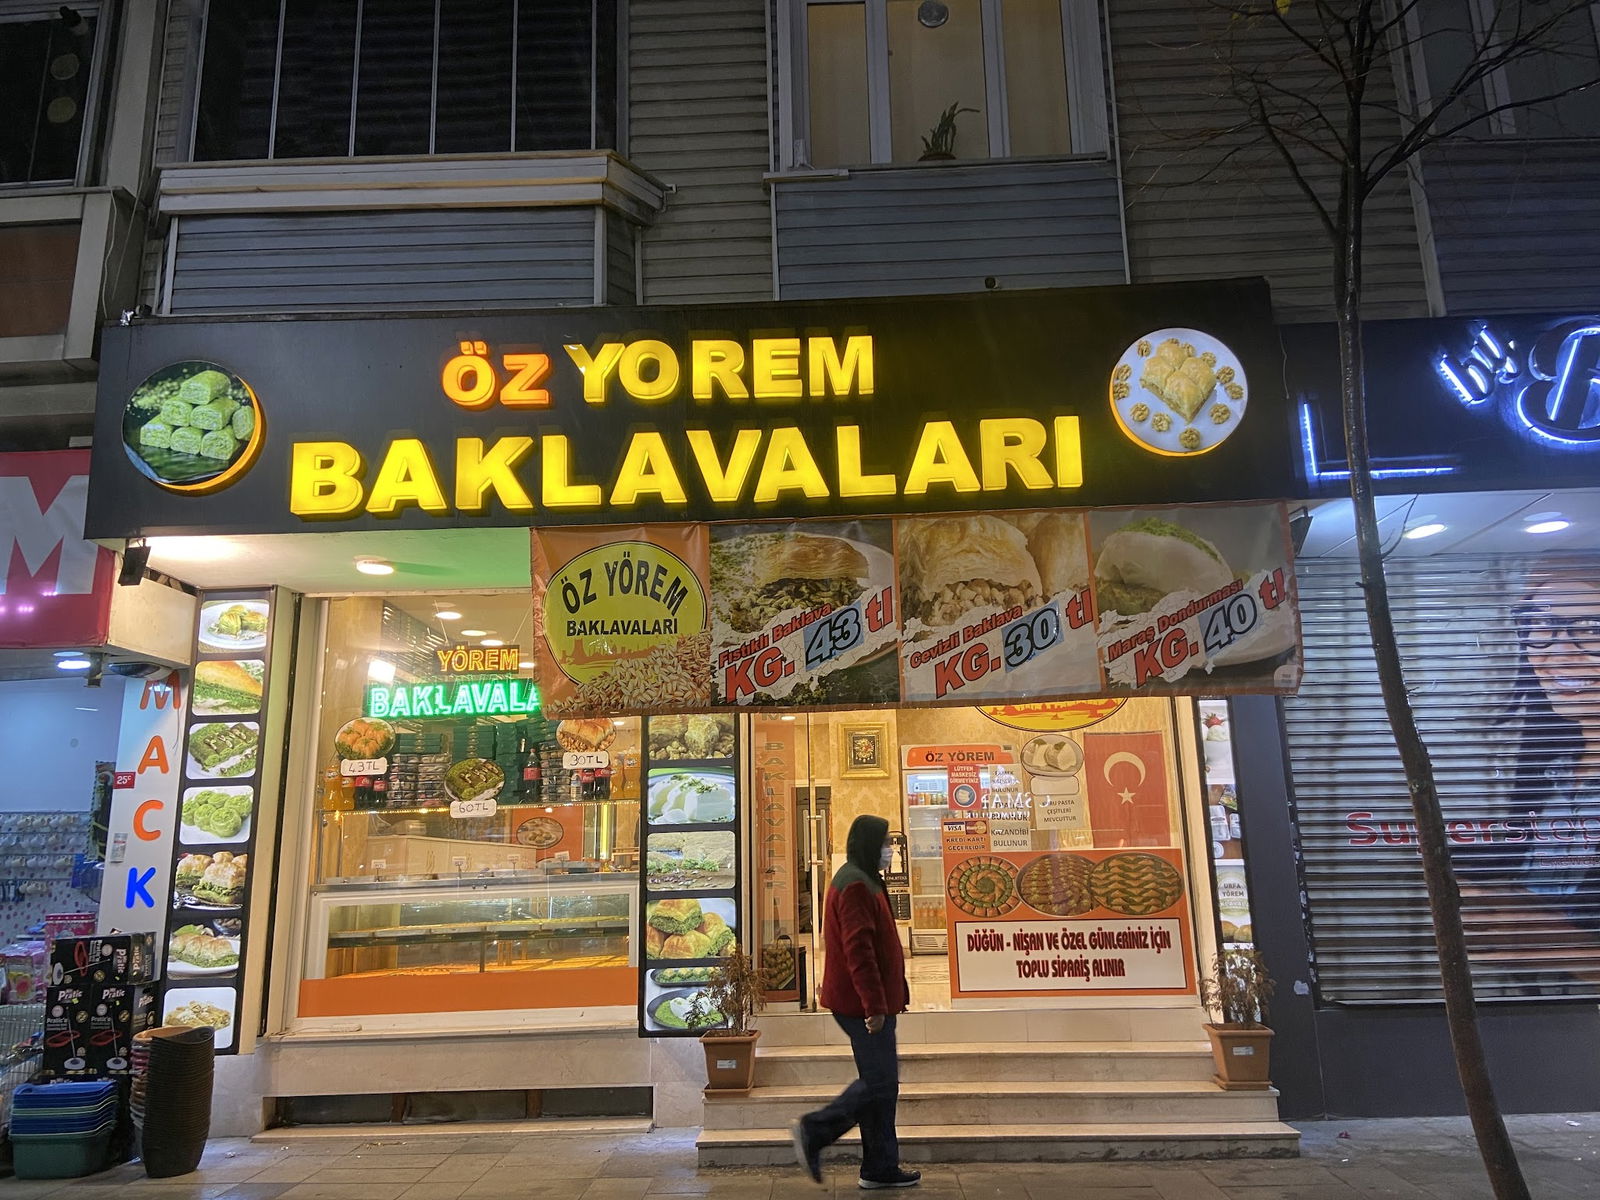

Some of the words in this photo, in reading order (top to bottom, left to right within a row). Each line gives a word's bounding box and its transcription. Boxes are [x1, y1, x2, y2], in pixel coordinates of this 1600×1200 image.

[442, 341, 551, 406] ÖZ
[563, 335, 875, 403] YOREM
[290, 416, 1083, 515] BAKLAVALARI
[561, 568, 597, 614] ÖZ
[604, 551, 688, 616] YÖREM
[566, 618, 678, 637] BAKLAVALARI
[718, 633, 769, 669] Fıstıklı
[772, 603, 832, 643] Baklava
[725, 646, 795, 703] KG.
[805, 607, 861, 665] 43
[865, 586, 893, 633] tl
[910, 634, 961, 669] Cevizli
[963, 605, 1022, 644] Baklava
[935, 642, 1001, 699] KG.
[1005, 608, 1060, 667] 30
[1066, 588, 1093, 630] tl
[1108, 625, 1154, 663] Maraş
[1157, 579, 1243, 633] Dondurması
[1134, 628, 1199, 688] KG.
[1203, 593, 1258, 651] 40
[1259, 567, 1286, 610] tl
[437, 646, 520, 672] YÖREM
[348, 761, 380, 773] 43TL
[925, 751, 944, 762] ÖZ
[948, 749, 995, 761] YÖREM
[457, 802, 489, 813] 60TL
[967, 929, 1004, 951] DÜĞÜN
[1013, 928, 1044, 956] NİŞAN
[1047, 931, 1059, 950] VE
[1061, 928, 1088, 950] ÖZEL
[1090, 926, 1149, 950] GÜNLERİNİZ
[1150, 926, 1171, 953] İÇİN
[1016, 959, 1049, 978] TOPLU
[1052, 954, 1090, 982] SİPARİŞ
[1092, 958, 1125, 977] ALINIR
[58, 989, 83, 1001] Pratic
[102, 988, 125, 1000] Pratic
